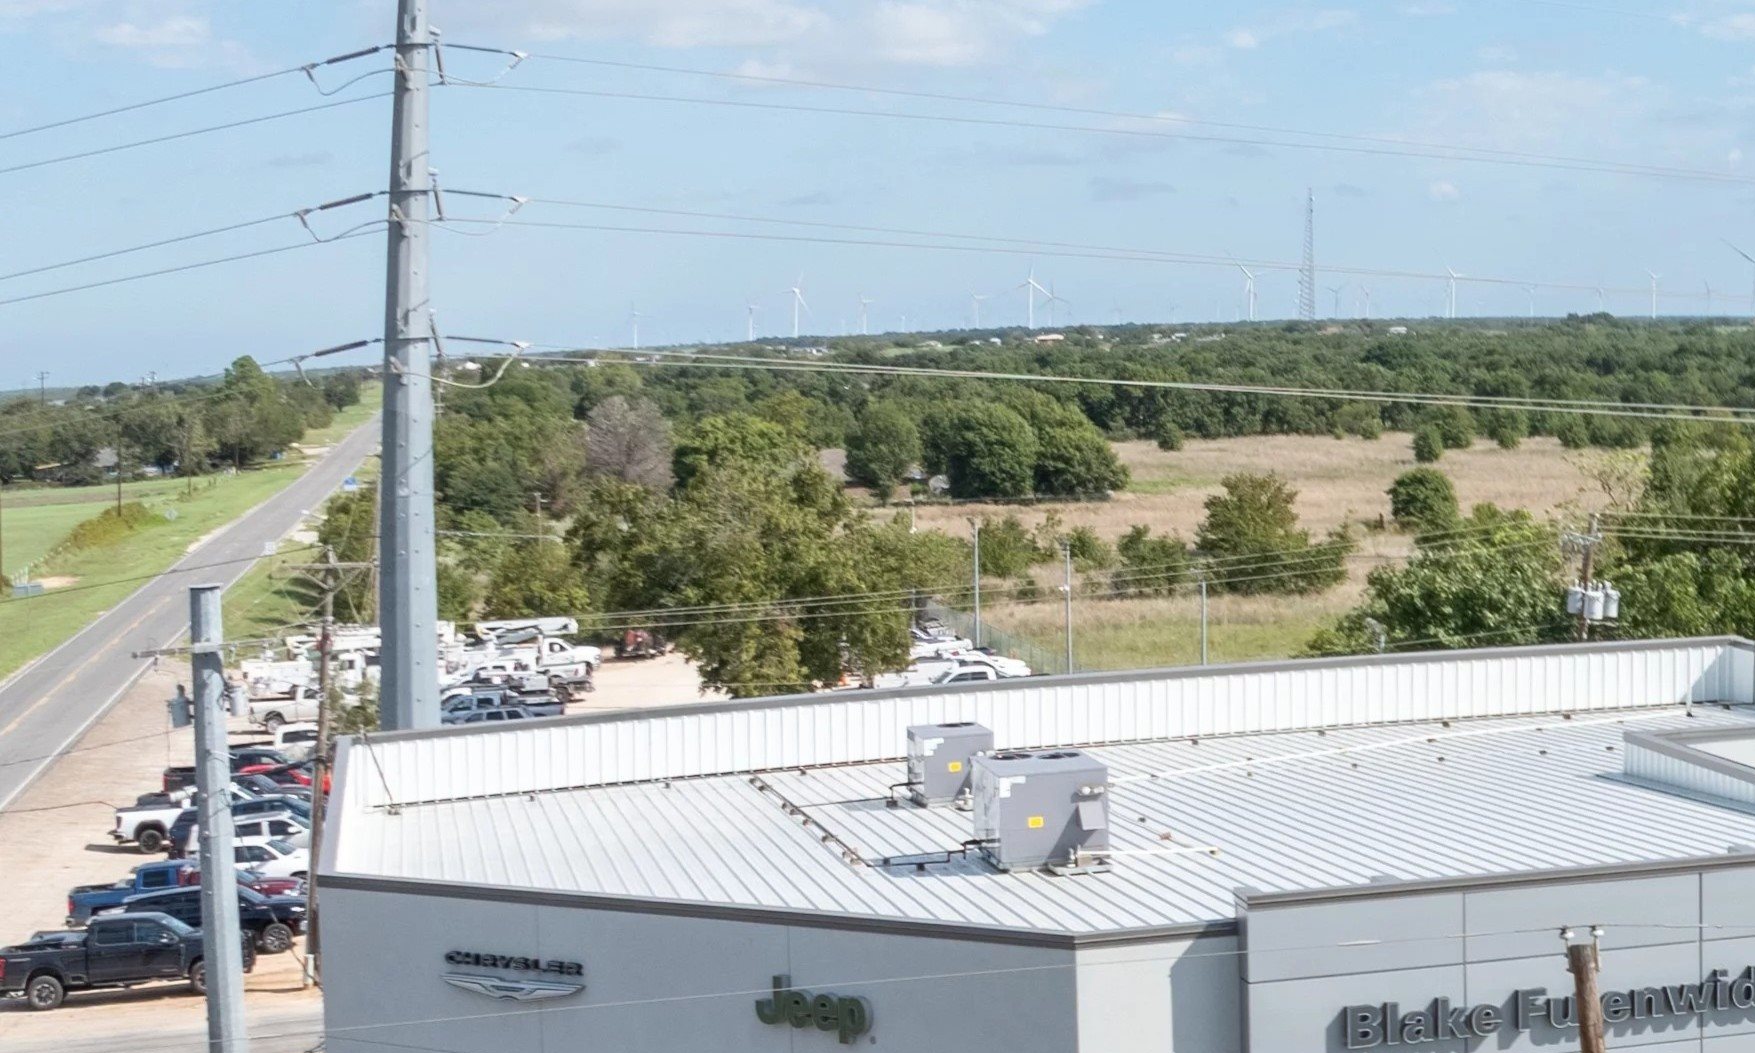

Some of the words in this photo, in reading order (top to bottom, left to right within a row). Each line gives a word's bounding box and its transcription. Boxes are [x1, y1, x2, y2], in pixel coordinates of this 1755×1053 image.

[444, 950, 585, 977] CHRYSLER
[755, 974, 874, 1045] Jeep
[1345, 996, 1503, 1050] Blake
